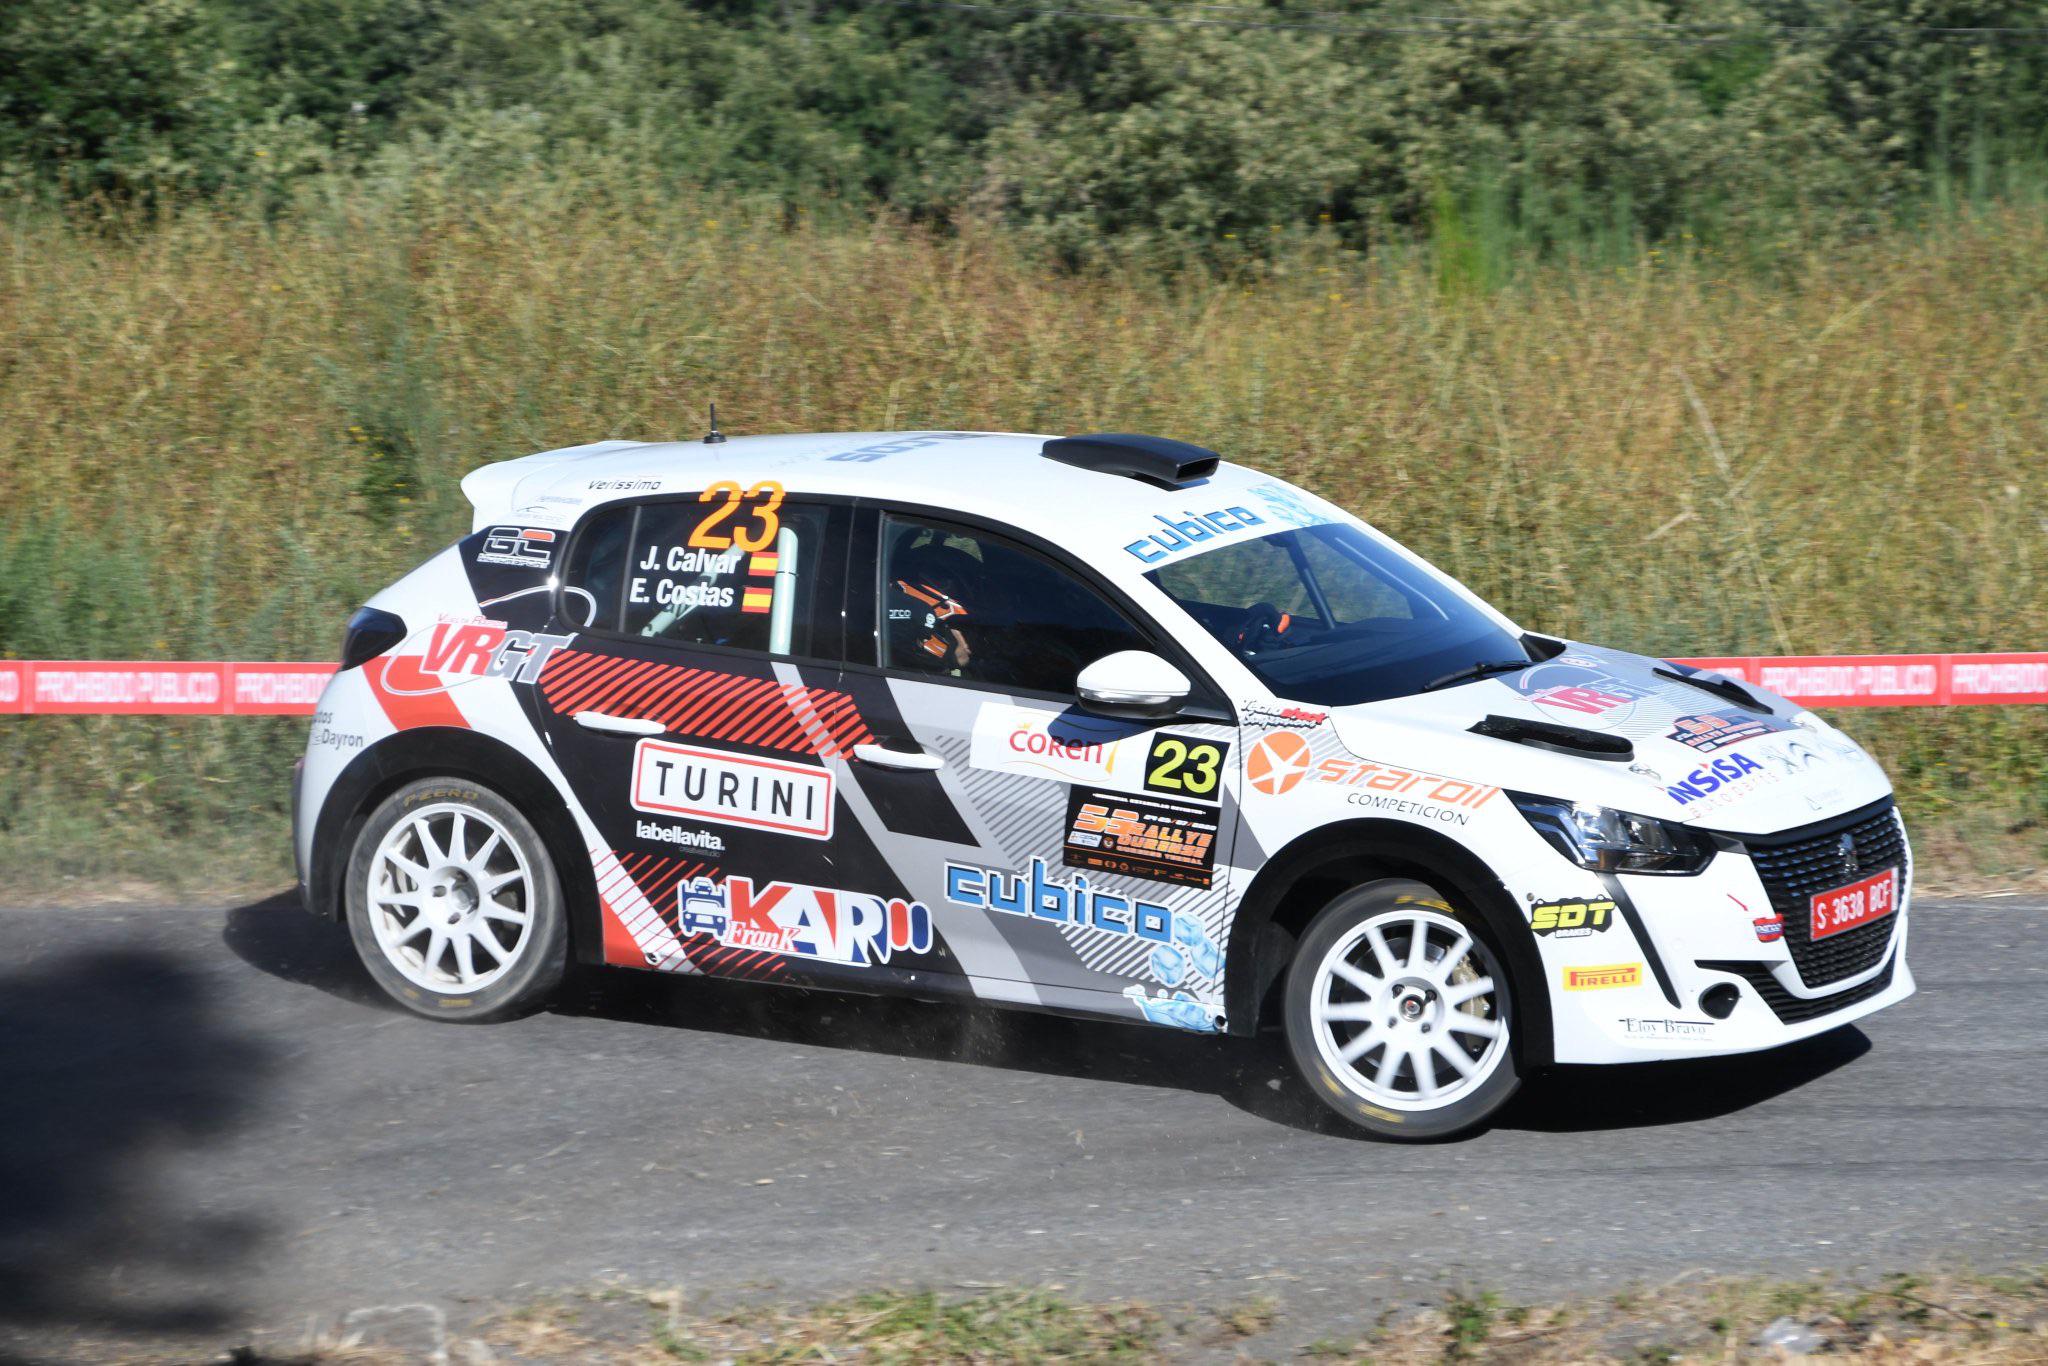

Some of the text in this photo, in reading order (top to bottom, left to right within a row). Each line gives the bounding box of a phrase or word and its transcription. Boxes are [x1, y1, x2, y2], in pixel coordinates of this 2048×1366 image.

[688, 480, 786, 552] 23
[1124, 506, 1266, 563] cubico
[640, 546, 741, 574] J. Calvar
[629, 577, 734, 607] E. Costas
[419, 623, 579, 685] VRGT
[322, 728, 363, 751] Dayron
[1148, 740, 1221, 793] 23
[1317, 758, 1500, 809] staroil
[656, 761, 814, 820] TURINI
[1347, 792, 1470, 826] COMPETICION
[1129, 822, 1213, 848] RALLYE
[946, 857, 1173, 943] cubico
[1531, 902, 1615, 929] SDT
[1817, 903, 1827, 929] S
[1832, 890, 1865, 924] 3638
[1570, 967, 1635, 986] PIRELLI
